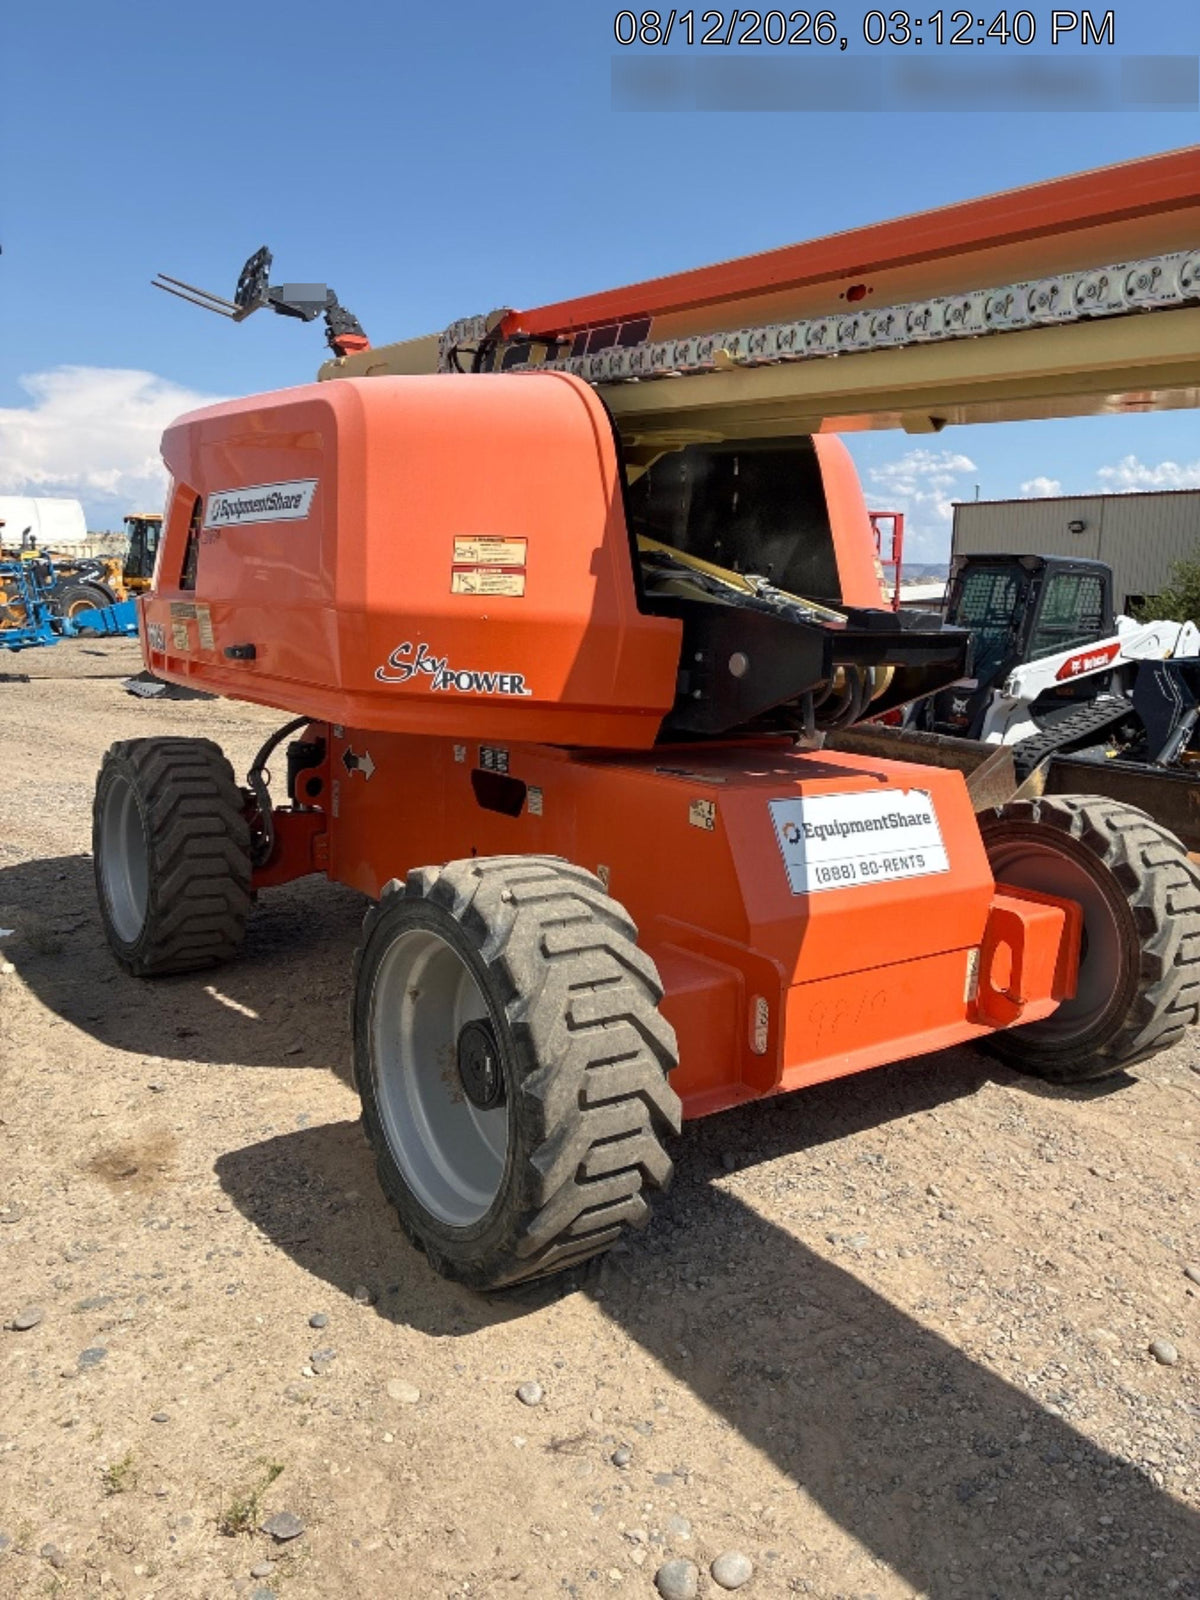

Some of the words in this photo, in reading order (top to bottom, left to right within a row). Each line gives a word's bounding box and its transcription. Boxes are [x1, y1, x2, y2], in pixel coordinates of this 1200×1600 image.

[219, 491, 303, 520] EquipmentShare
[801, 812, 932, 842] EquipmentShare
[815, 864, 856, 885] (888)
